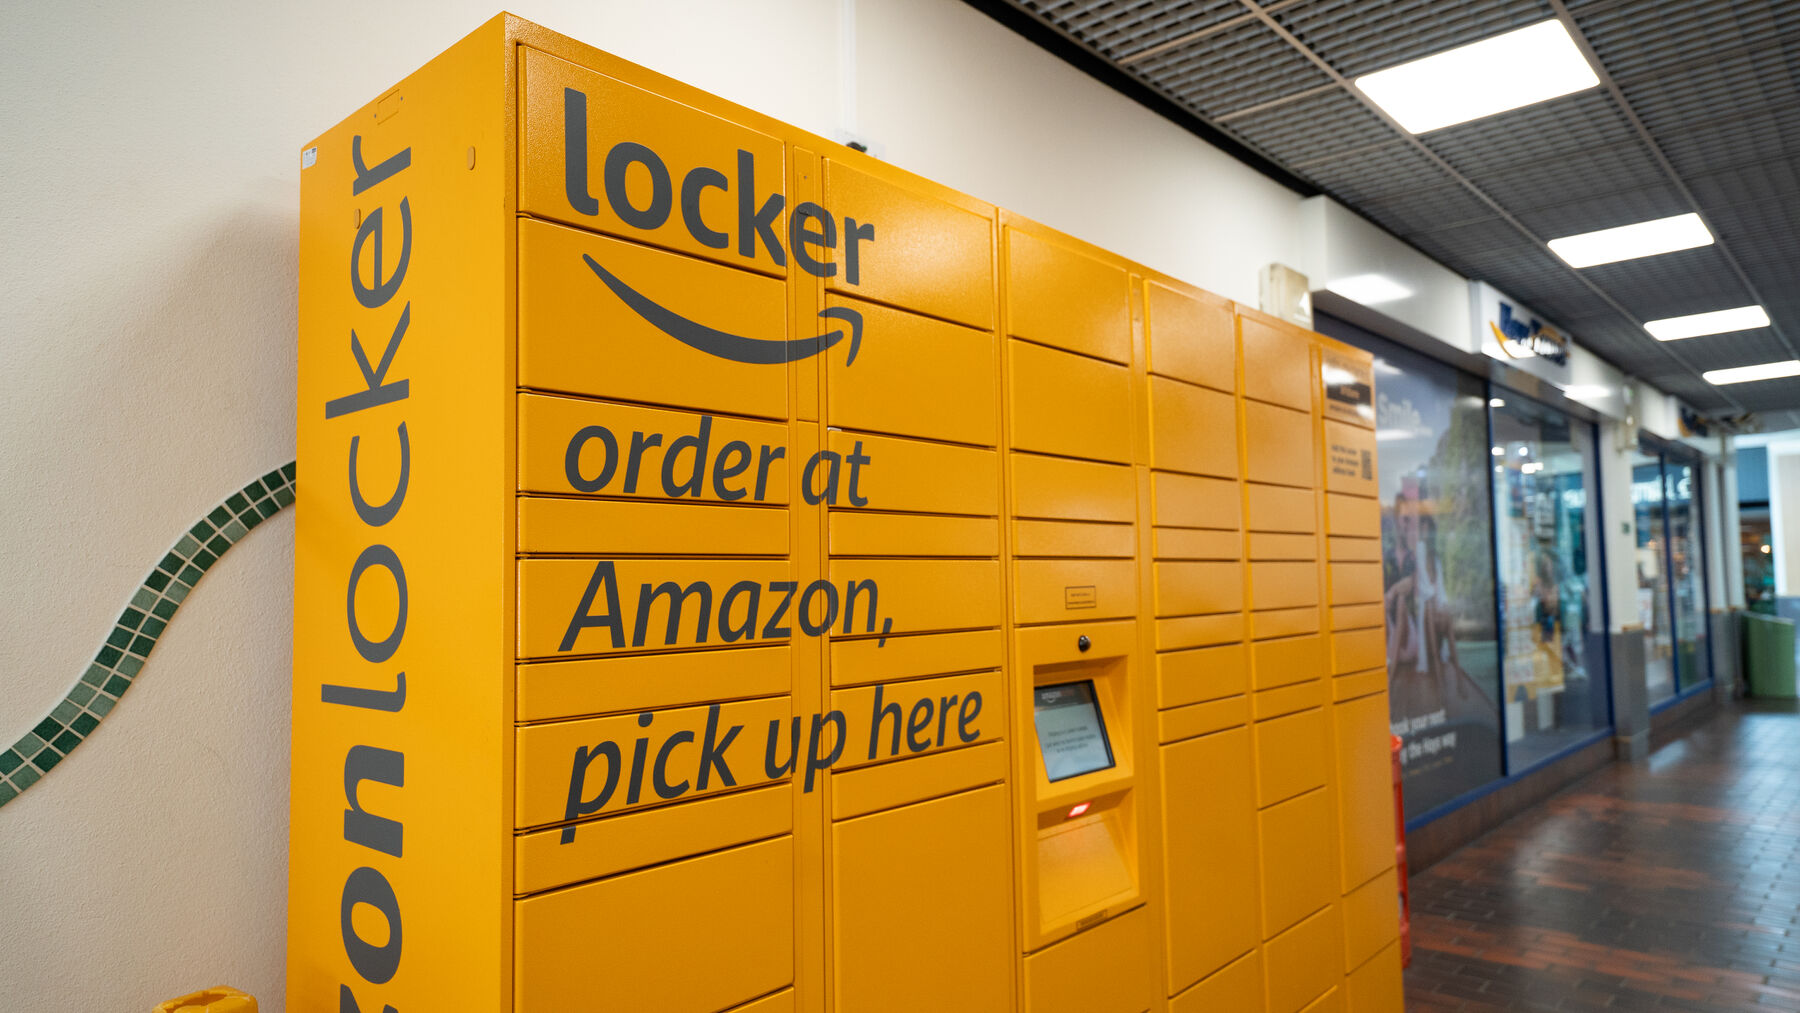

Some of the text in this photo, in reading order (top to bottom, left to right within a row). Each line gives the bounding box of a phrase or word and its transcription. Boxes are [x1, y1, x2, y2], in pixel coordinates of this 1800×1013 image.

[564, 87, 876, 286] locker
[322, 134, 412, 713] locker
[564, 415, 872, 508] order at
[558, 560, 894, 649] Amazon,
[560, 685, 984, 845] pick up here
